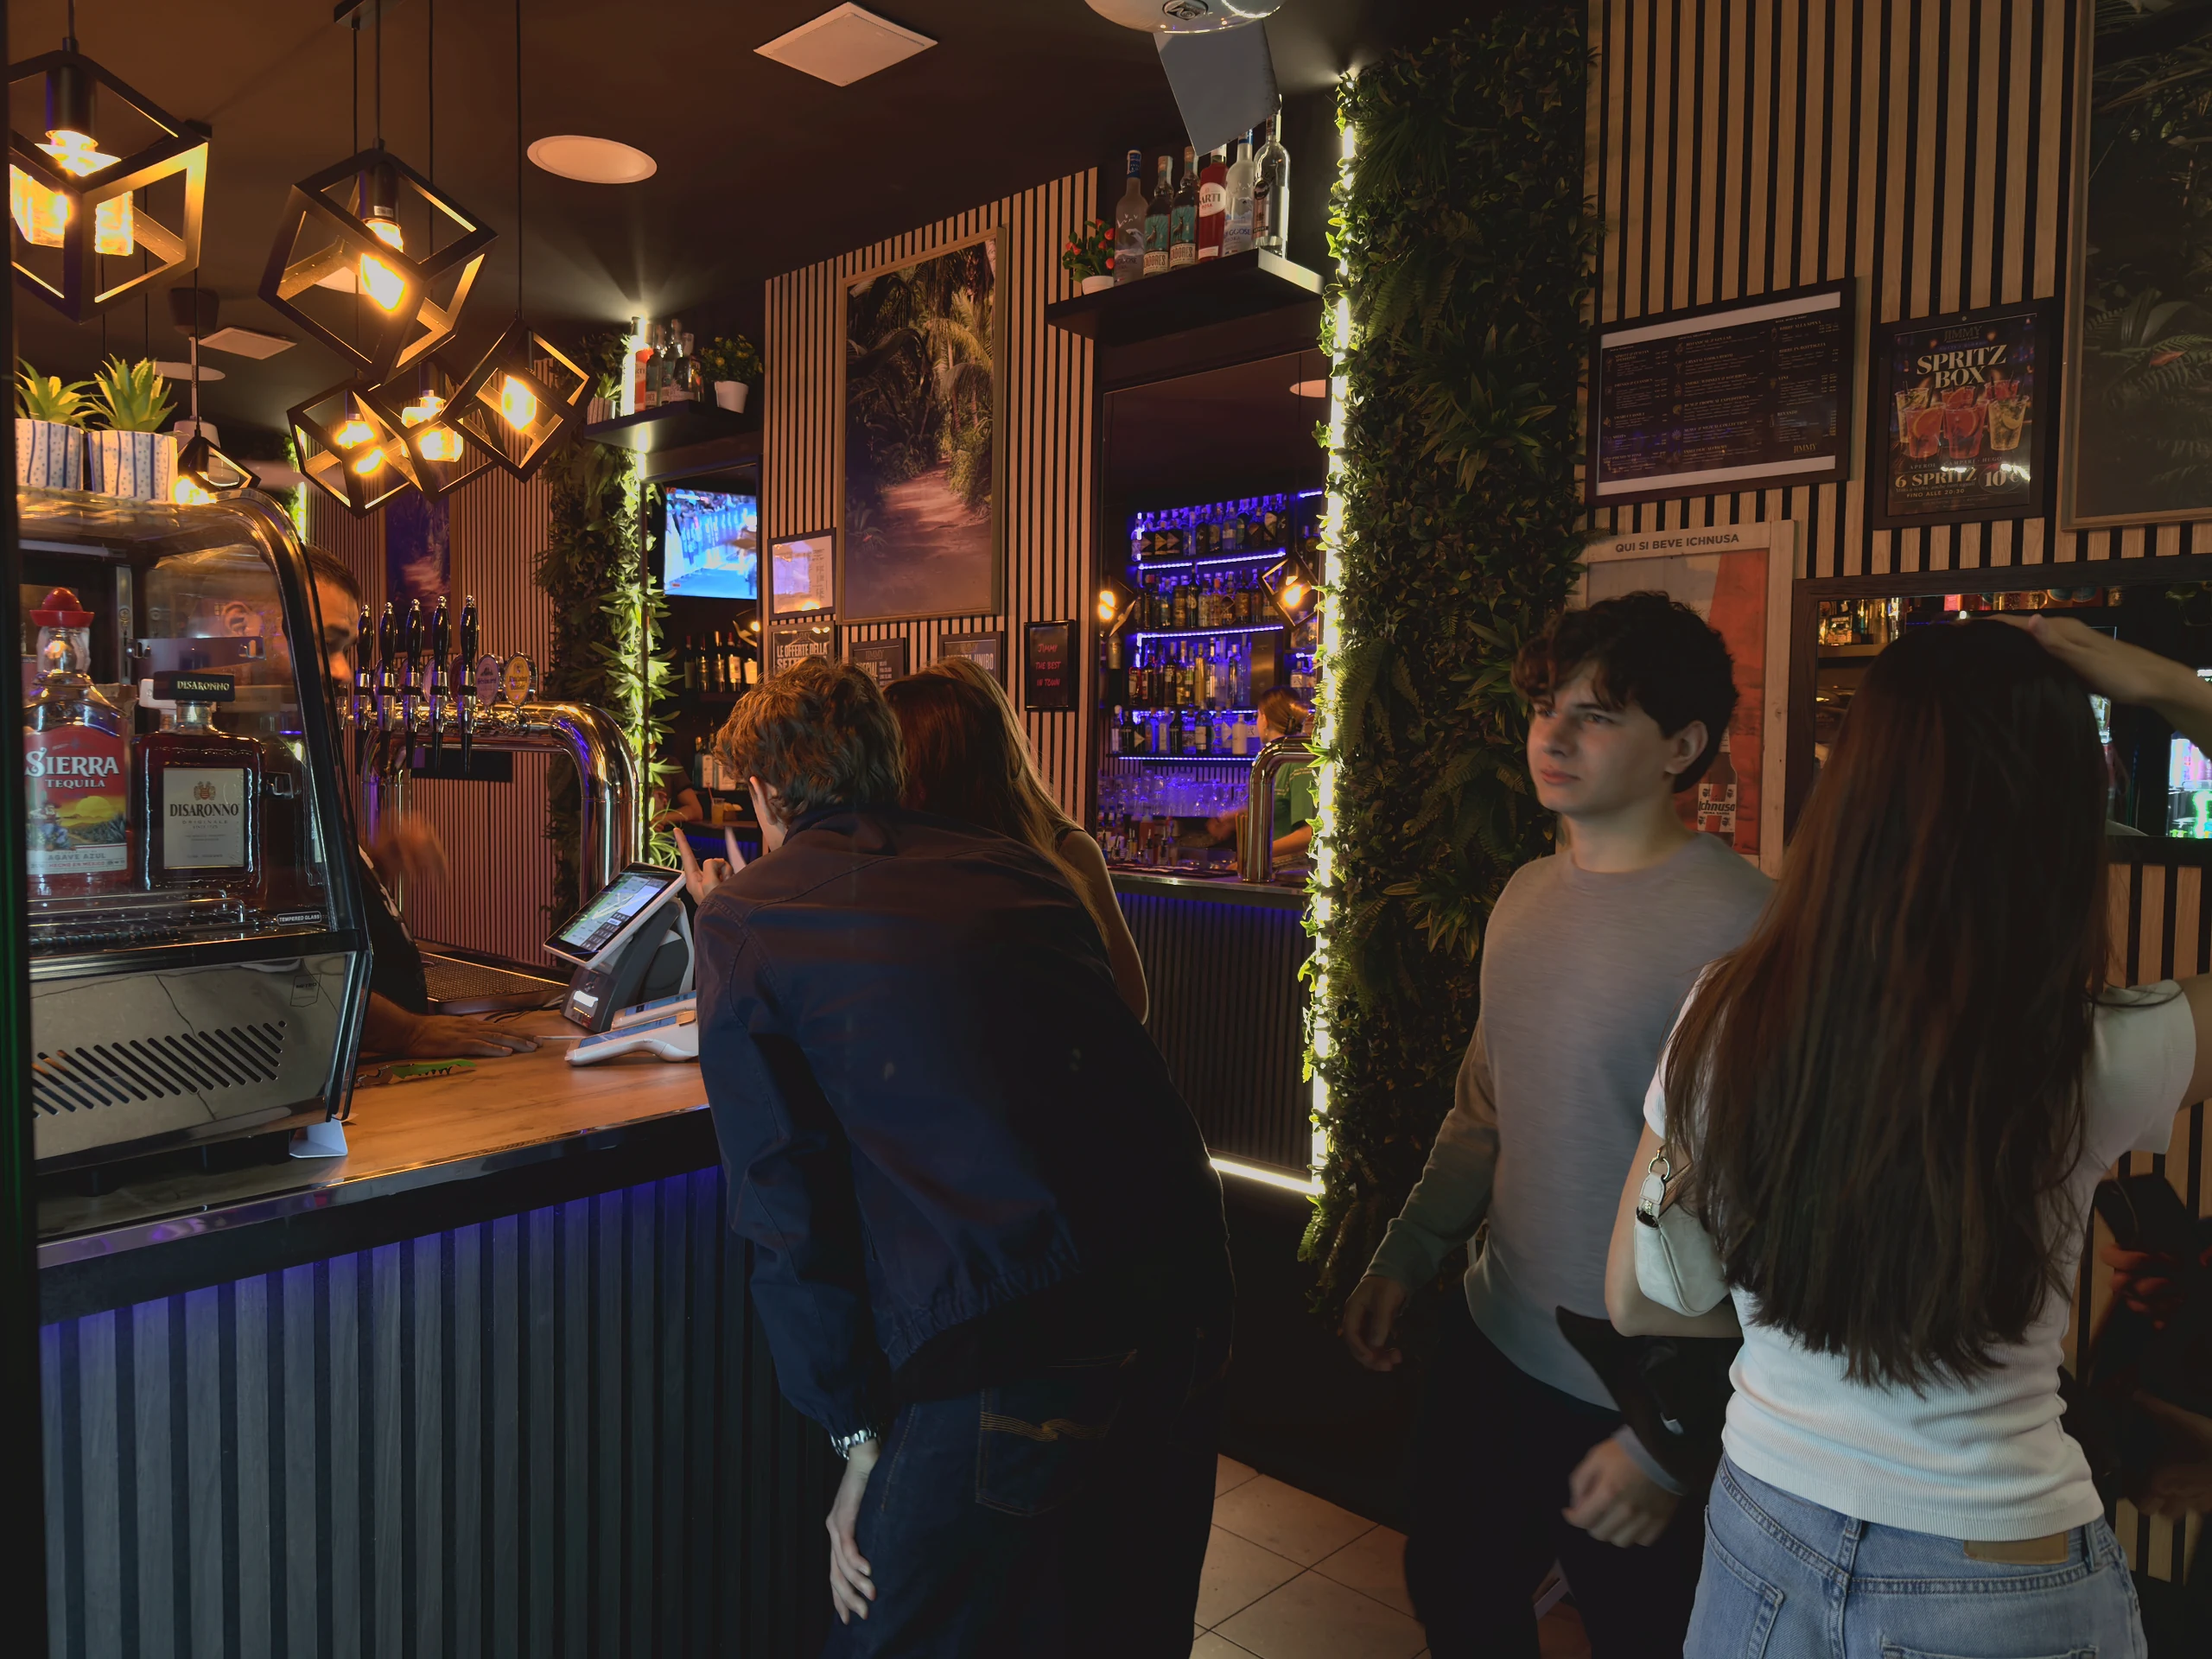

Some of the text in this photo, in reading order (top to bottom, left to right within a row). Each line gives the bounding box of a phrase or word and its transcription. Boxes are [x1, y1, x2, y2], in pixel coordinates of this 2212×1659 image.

[1944, 325, 1983, 341] JIMMY
[1916, 344, 2007, 375] SPRITZ
[1935, 365, 1986, 390] BOX
[1895, 474, 1907, 488] 6
[1911, 467, 1977, 487] SPRITZ
[1984, 470, 2006, 487] 10
[1616, 533, 1739, 552] QUI SI BEVE ICHNUSA
[777, 642, 828, 658] LE OFFERTE DELLA
[1038, 643, 1058, 654] JIMMY
[1035, 661, 1061, 671] THE BEST
[176, 680, 230, 691] DISARONNO
[1045, 678, 1061, 687] TOWN
[25, 747, 120, 778] SIERRA
[44, 779, 106, 790] TEQUILA
[169, 803, 239, 818] DISARONNO
